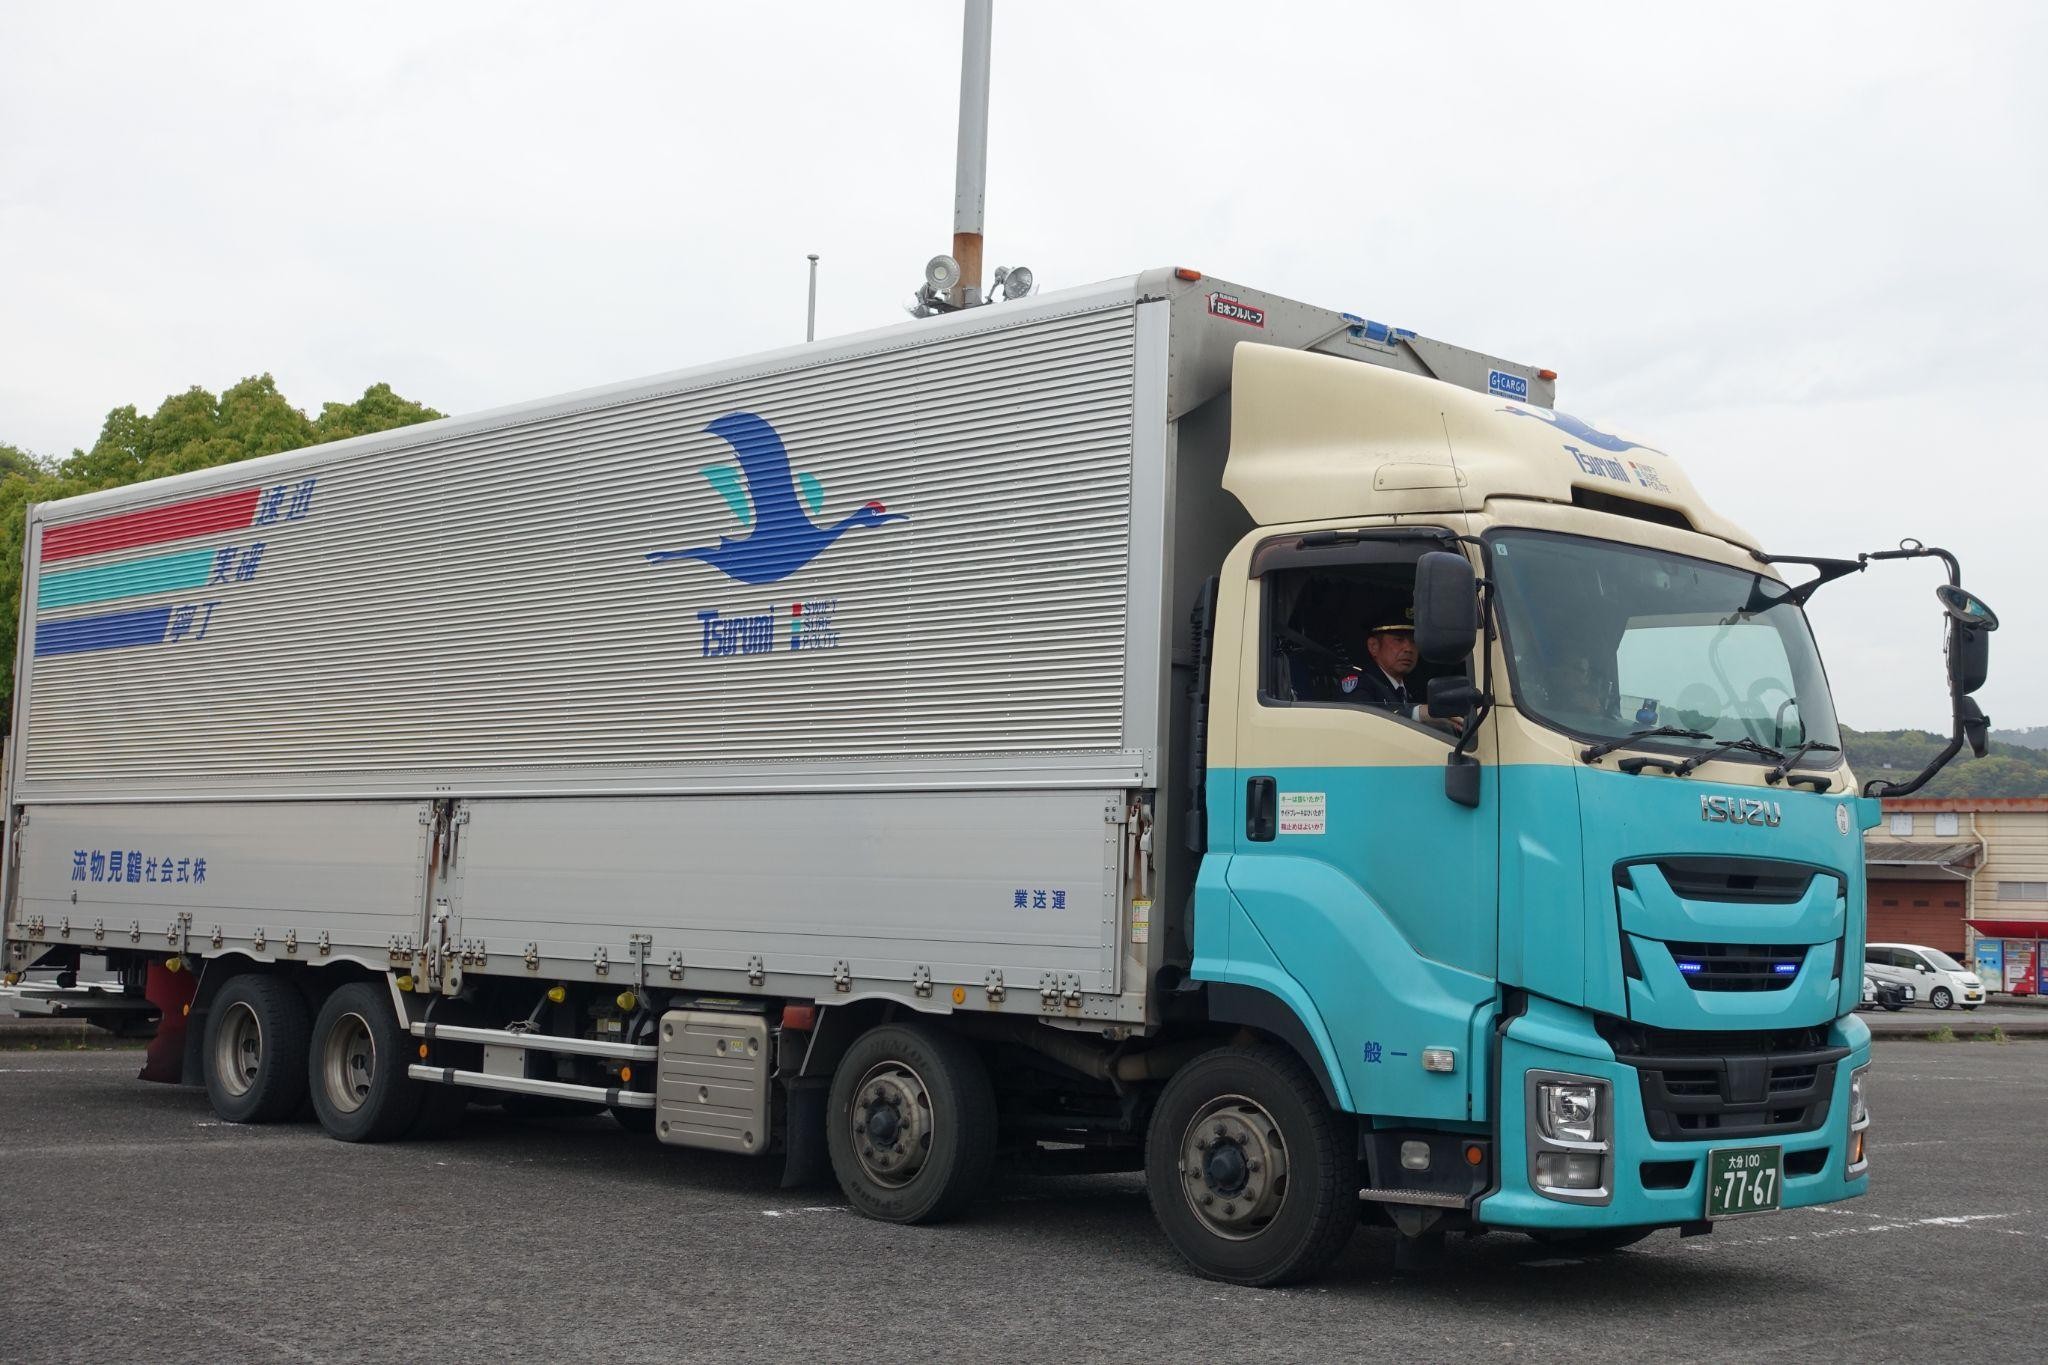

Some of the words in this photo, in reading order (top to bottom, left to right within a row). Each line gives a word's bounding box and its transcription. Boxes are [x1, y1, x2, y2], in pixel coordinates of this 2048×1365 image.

[1217, 302, 1263, 323] 日本フルハーフ
[1563, 445, 1631, 483] Tsurumi
[697, 604, 775, 657] Tsurumi
[1700, 794, 1781, 827] ISUZU
